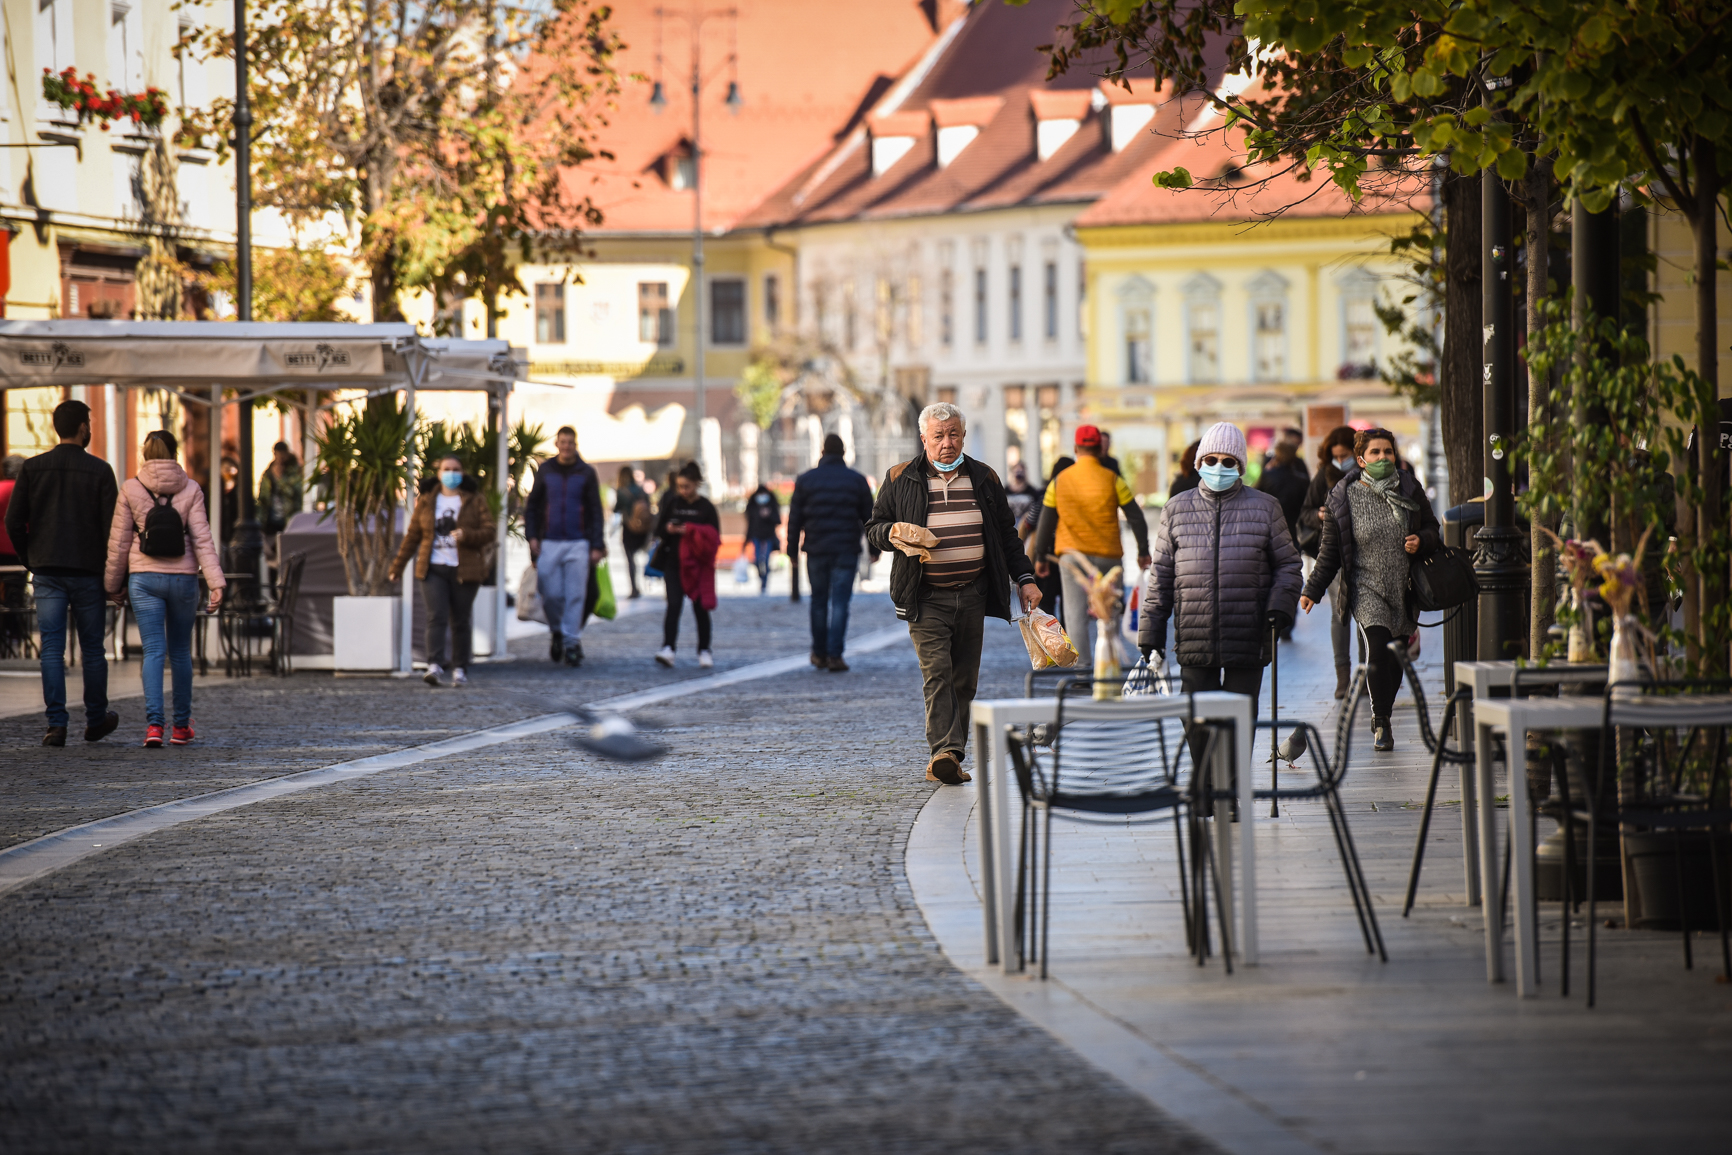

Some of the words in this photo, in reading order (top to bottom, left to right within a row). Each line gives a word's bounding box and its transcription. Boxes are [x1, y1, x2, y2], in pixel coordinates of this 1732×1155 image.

[23, 353, 51, 362] BETTY
[66, 354, 81, 363] ICE
[288, 354, 316, 363] BETTY
[332, 354, 347, 363] ICE
